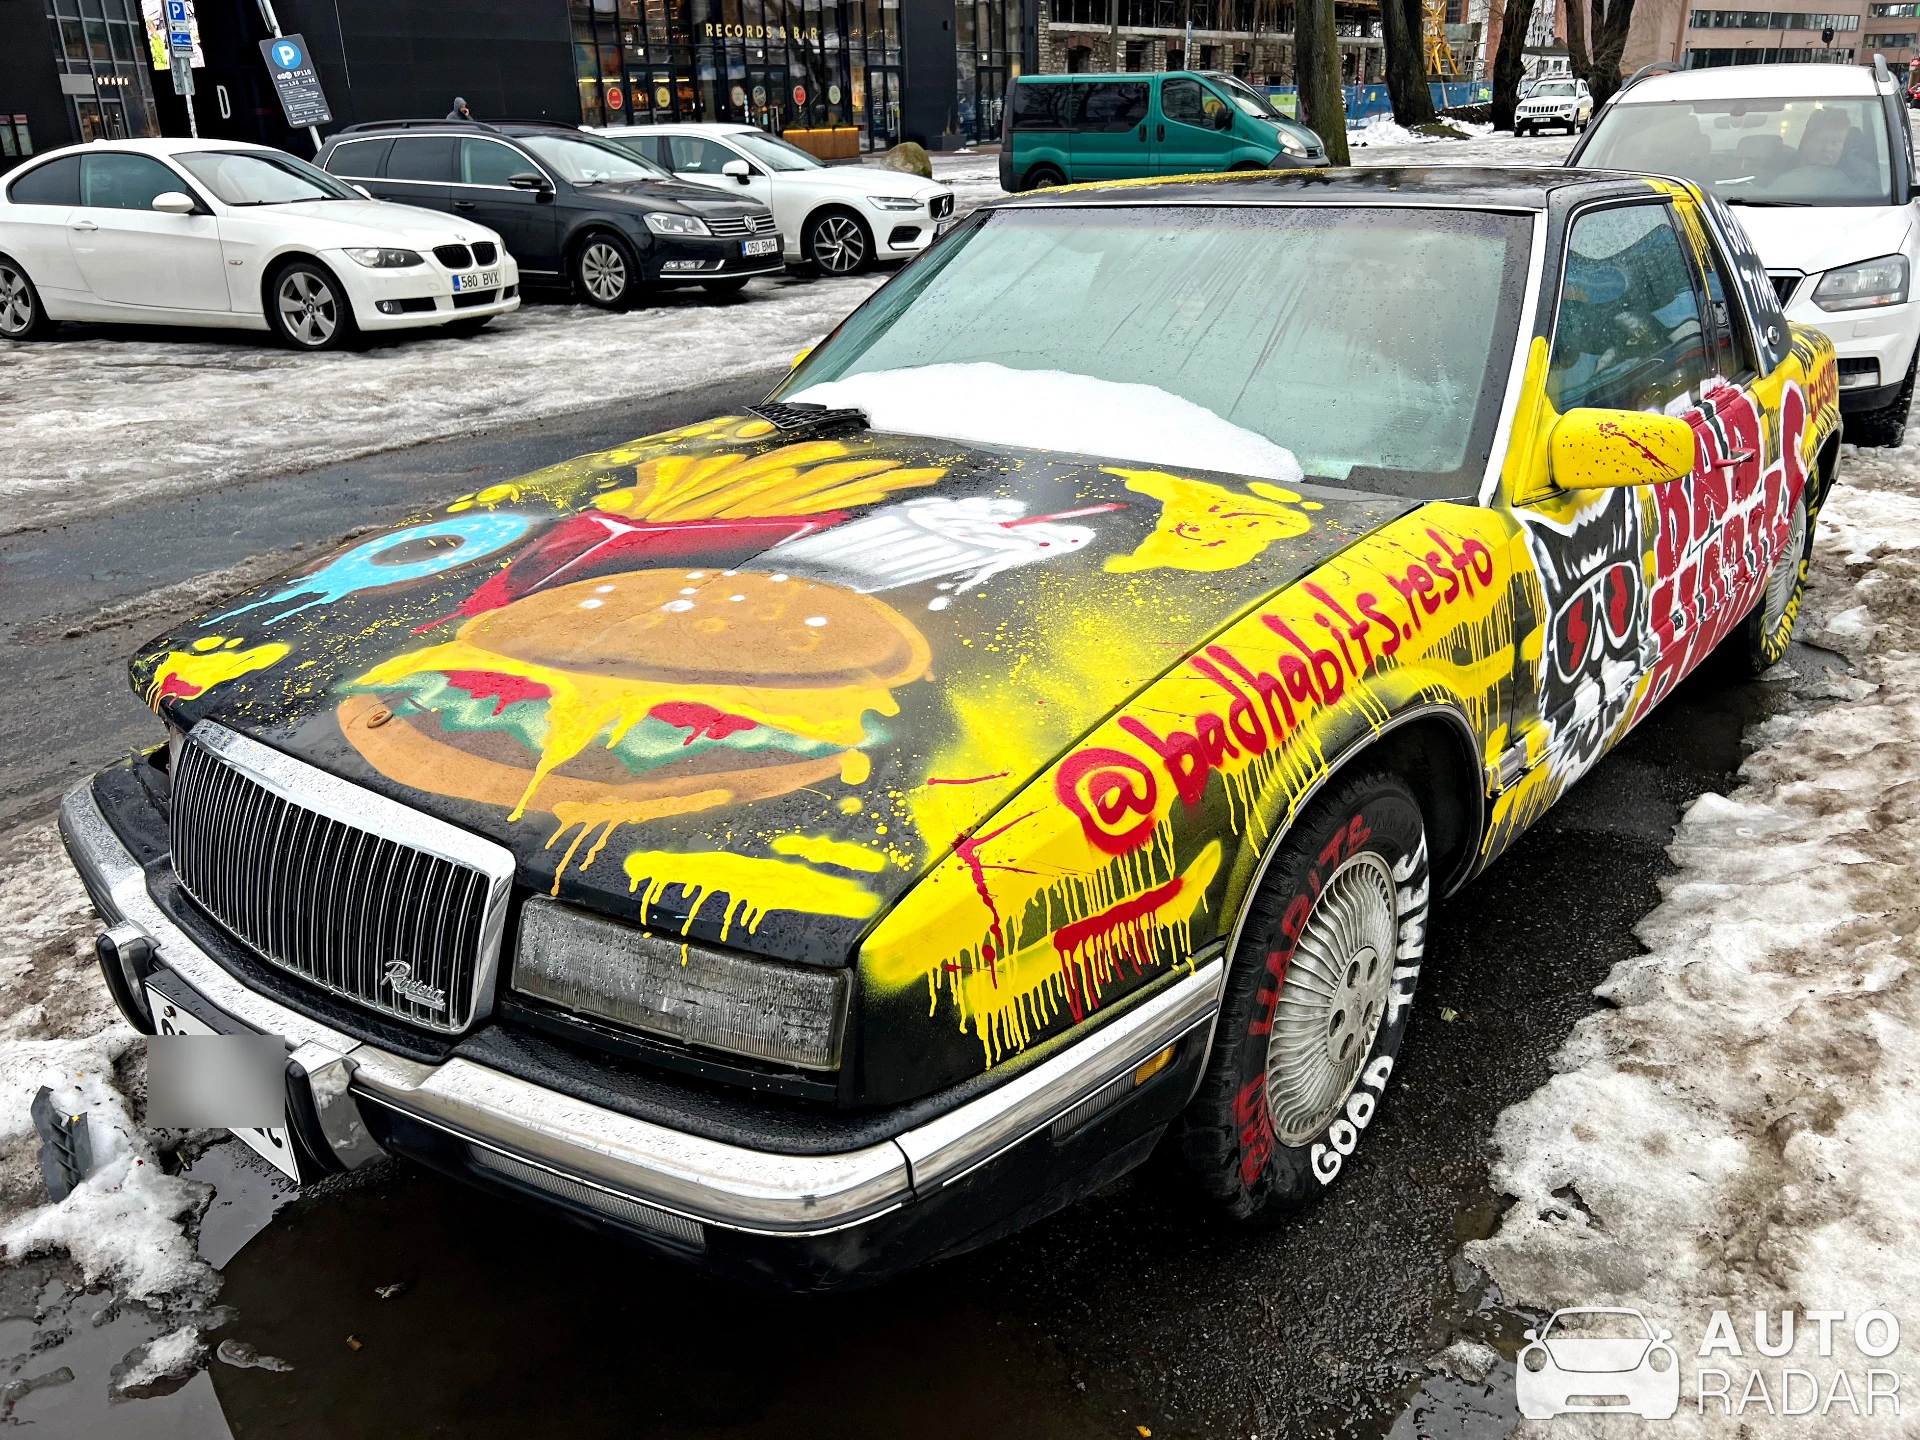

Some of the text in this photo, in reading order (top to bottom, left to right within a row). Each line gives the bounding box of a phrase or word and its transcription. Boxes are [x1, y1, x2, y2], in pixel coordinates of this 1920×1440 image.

[171, 3, 181, 19] P
[705, 23, 818, 40] RECORDS & BAR
[278, 46, 295, 66] P
[216, 85, 231, 119] D
[1709, 192, 1758, 256] GOO
[761, 239, 776, 252] BMH
[461, 271, 499, 288] 580 BVX
[1740, 266, 1782, 314] TIME
[1054, 527, 1494, 855] @badhabits.resto
[1311, 1055, 1393, 1186] GOOD
[1386, 826, 1430, 1027] TIMES
